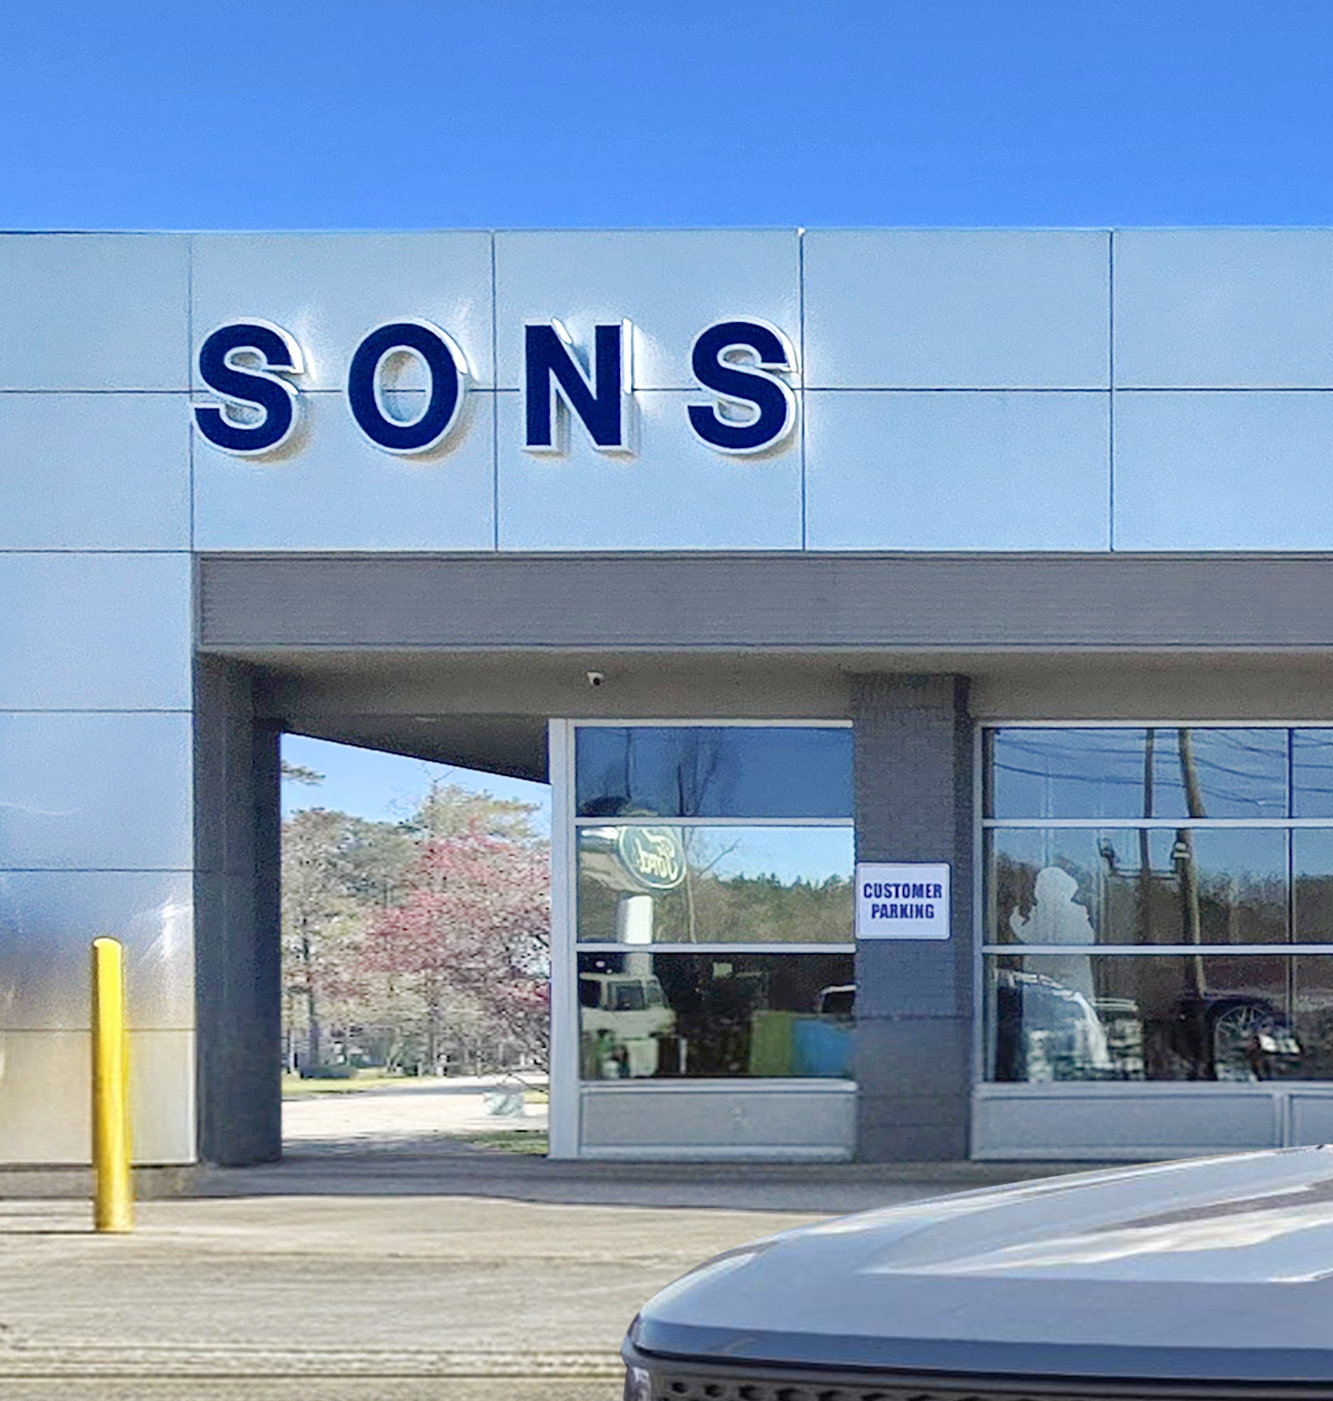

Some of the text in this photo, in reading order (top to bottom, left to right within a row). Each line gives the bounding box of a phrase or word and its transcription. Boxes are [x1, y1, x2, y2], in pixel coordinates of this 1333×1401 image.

[193, 319, 798, 455] SONS
[863, 883, 943, 899] CUSTOMER
[871, 904, 935, 919] PARKING
